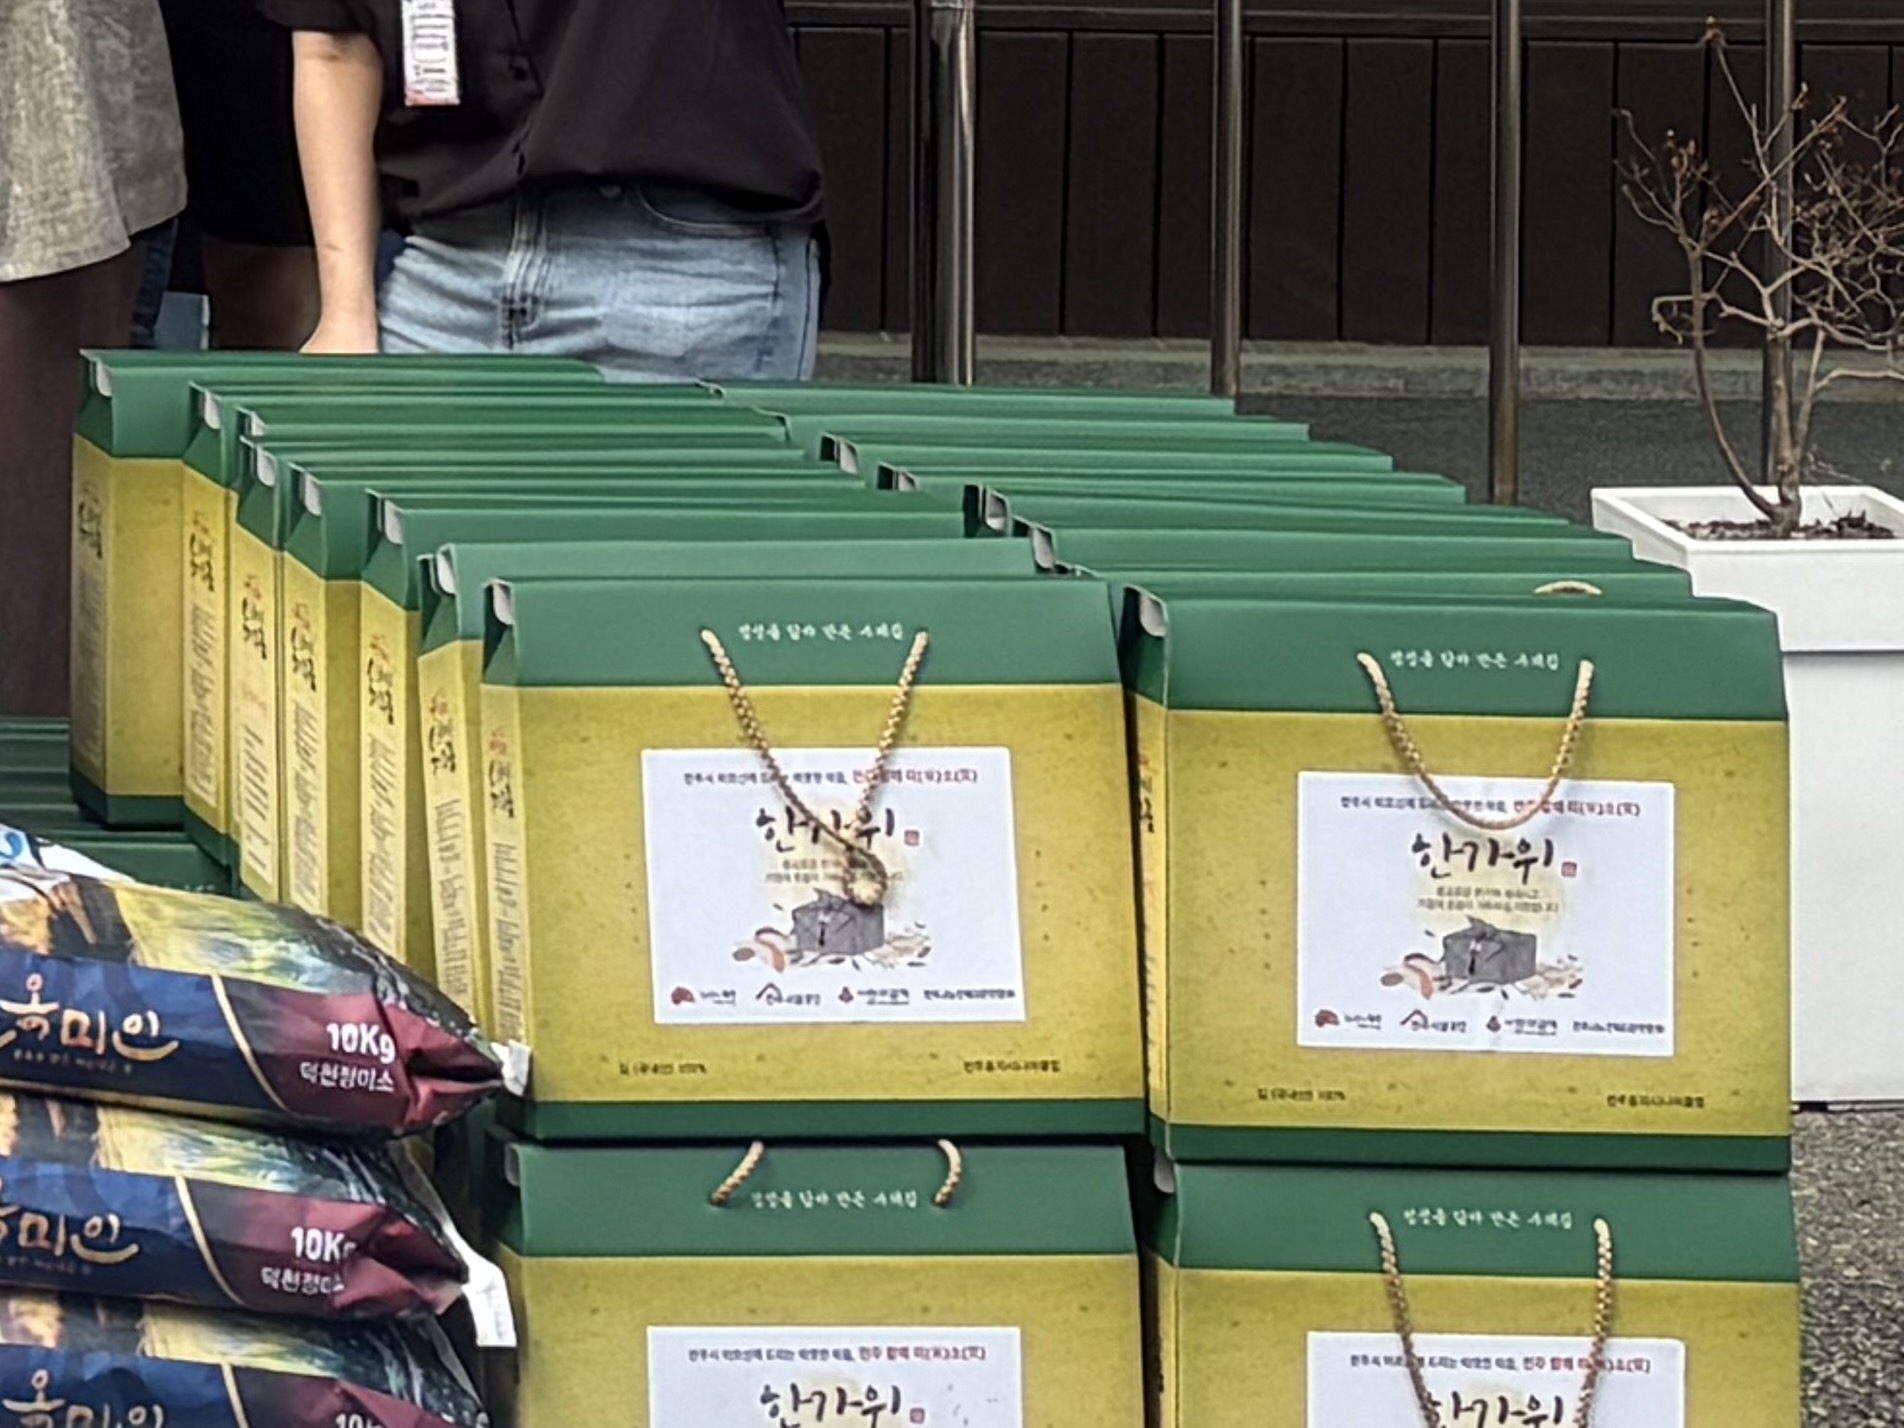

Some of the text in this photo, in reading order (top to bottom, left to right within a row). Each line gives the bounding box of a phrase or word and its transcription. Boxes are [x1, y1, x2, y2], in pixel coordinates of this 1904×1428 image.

[1412, 832, 1555, 885] 한가위
[326, 1022, 396, 1064] 10Kg
[760, 1383, 901, 1428] 한가위
